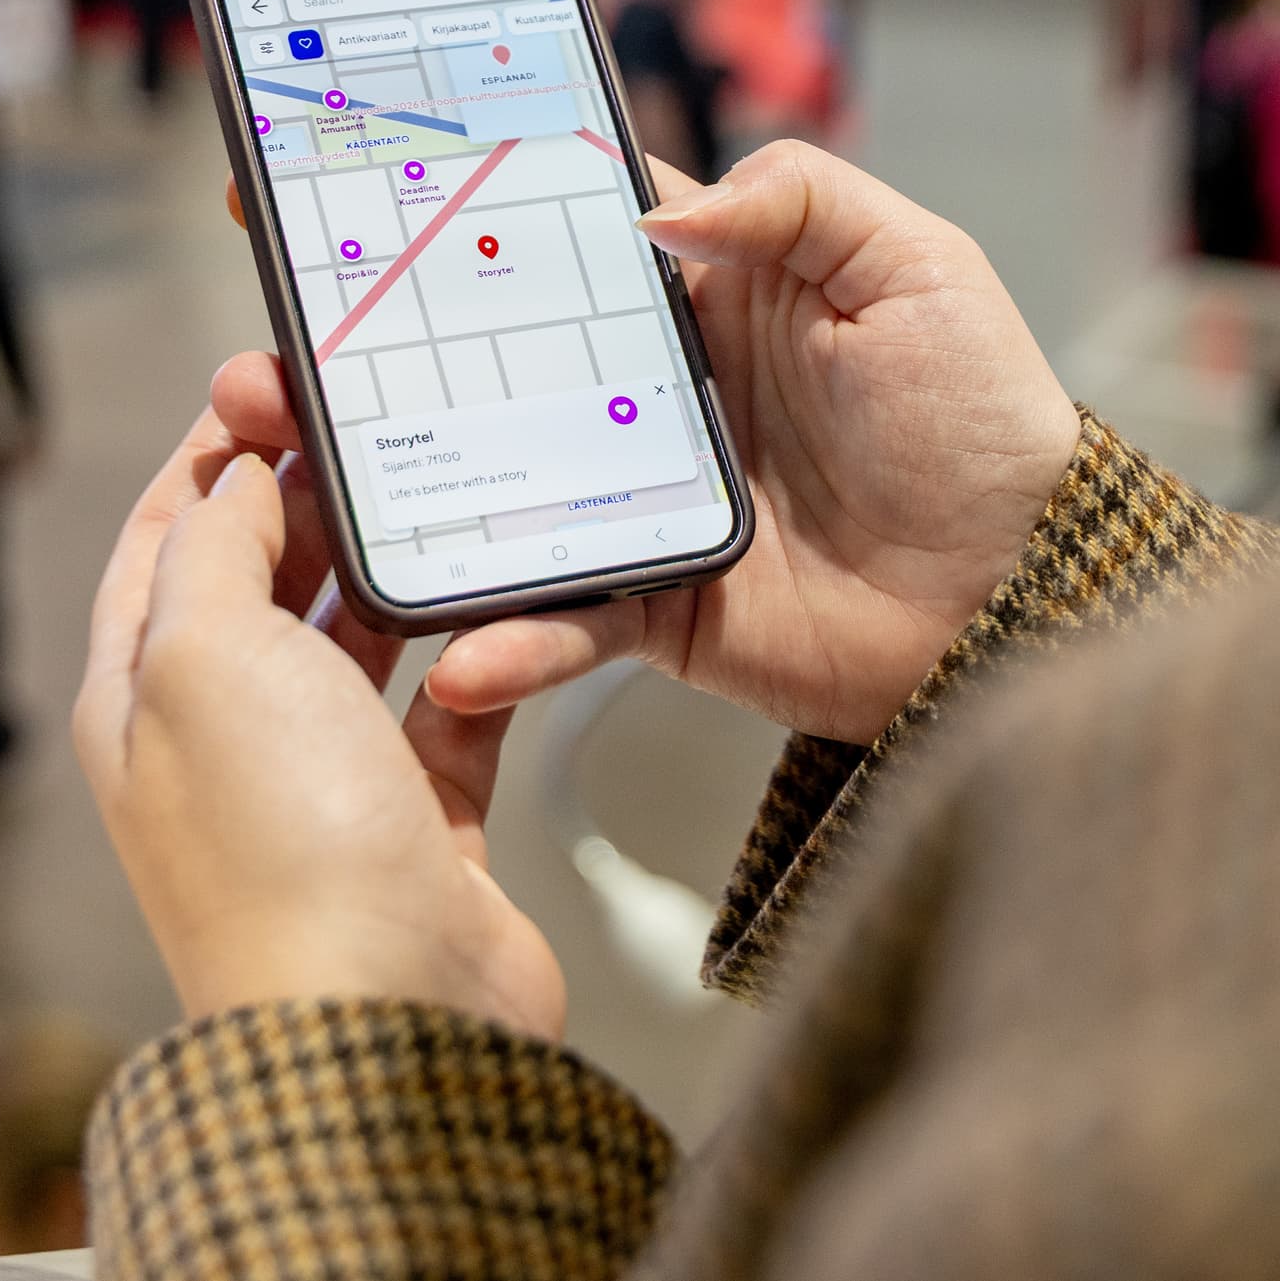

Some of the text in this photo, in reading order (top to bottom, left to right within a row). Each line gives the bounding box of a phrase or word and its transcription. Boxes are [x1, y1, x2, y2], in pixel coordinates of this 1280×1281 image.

[515, 11, 574, 26] Kustantajat
[432, 21, 492, 36] Kirjakaupat
[338, 30, 408, 46] Antikvariaatit
[481, 72, 537, 86] ESPLANADI
[395, 101, 419, 112] 2026
[421, 96, 468, 108] Euroopan
[316, 116, 341, 126] Daga
[320, 123, 367, 135] Amusantti
[400, 183, 440, 195] Deadline
[399, 194, 446, 206] Kustannus
[477, 266, 515, 278] Storytel
[376, 430, 434, 450] Storytel
[382, 451, 462, 475] Sijainti: 7f100
[388, 470, 528, 501] Life's better with a story
[567, 492, 633, 511] LASTENALUE
